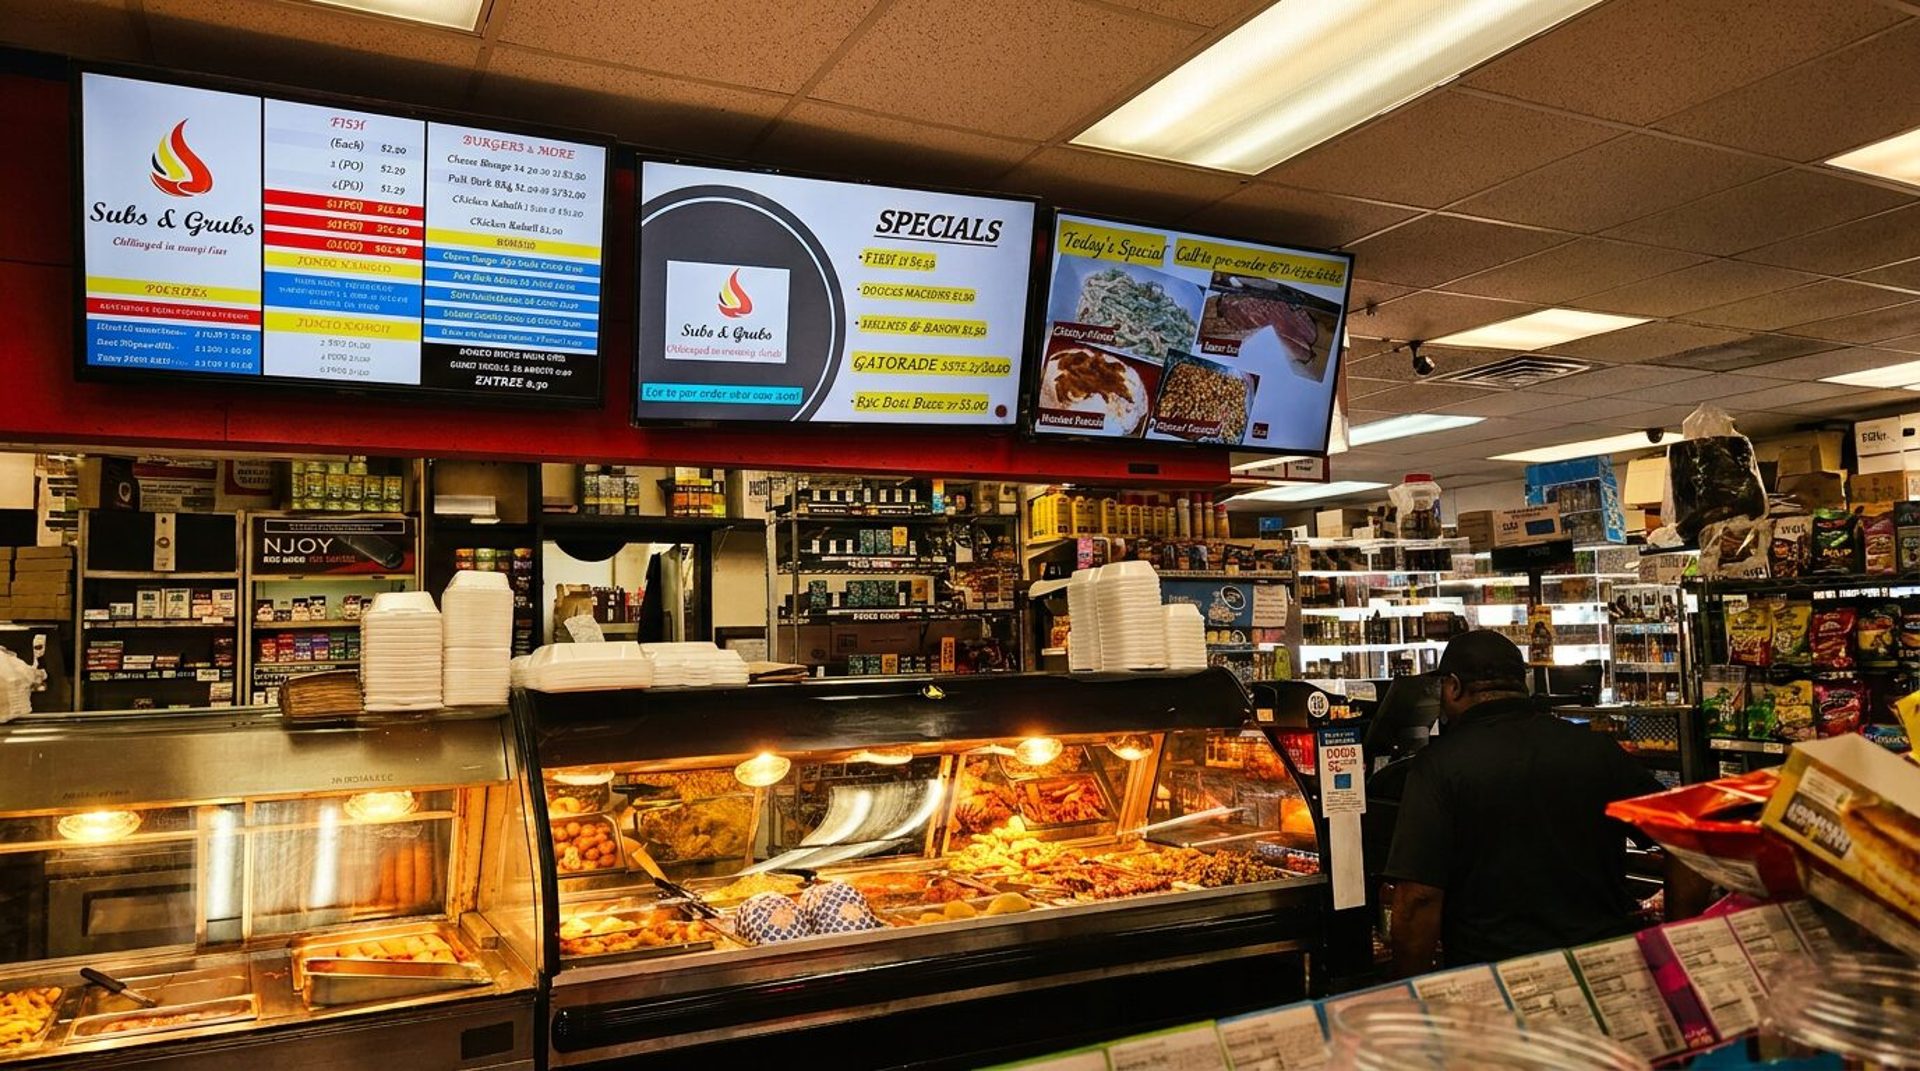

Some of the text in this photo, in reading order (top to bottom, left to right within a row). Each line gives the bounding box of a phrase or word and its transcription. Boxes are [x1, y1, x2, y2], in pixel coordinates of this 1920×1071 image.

[537, 147, 576, 160] MORE
[90, 201, 255, 237] Subs & Grubs
[875, 209, 1004, 243] SPECIALS
[681, 323, 773, 343] Subs & Grubs
[853, 355, 939, 371] GATORADE
[263, 537, 334, 554] NJOY
